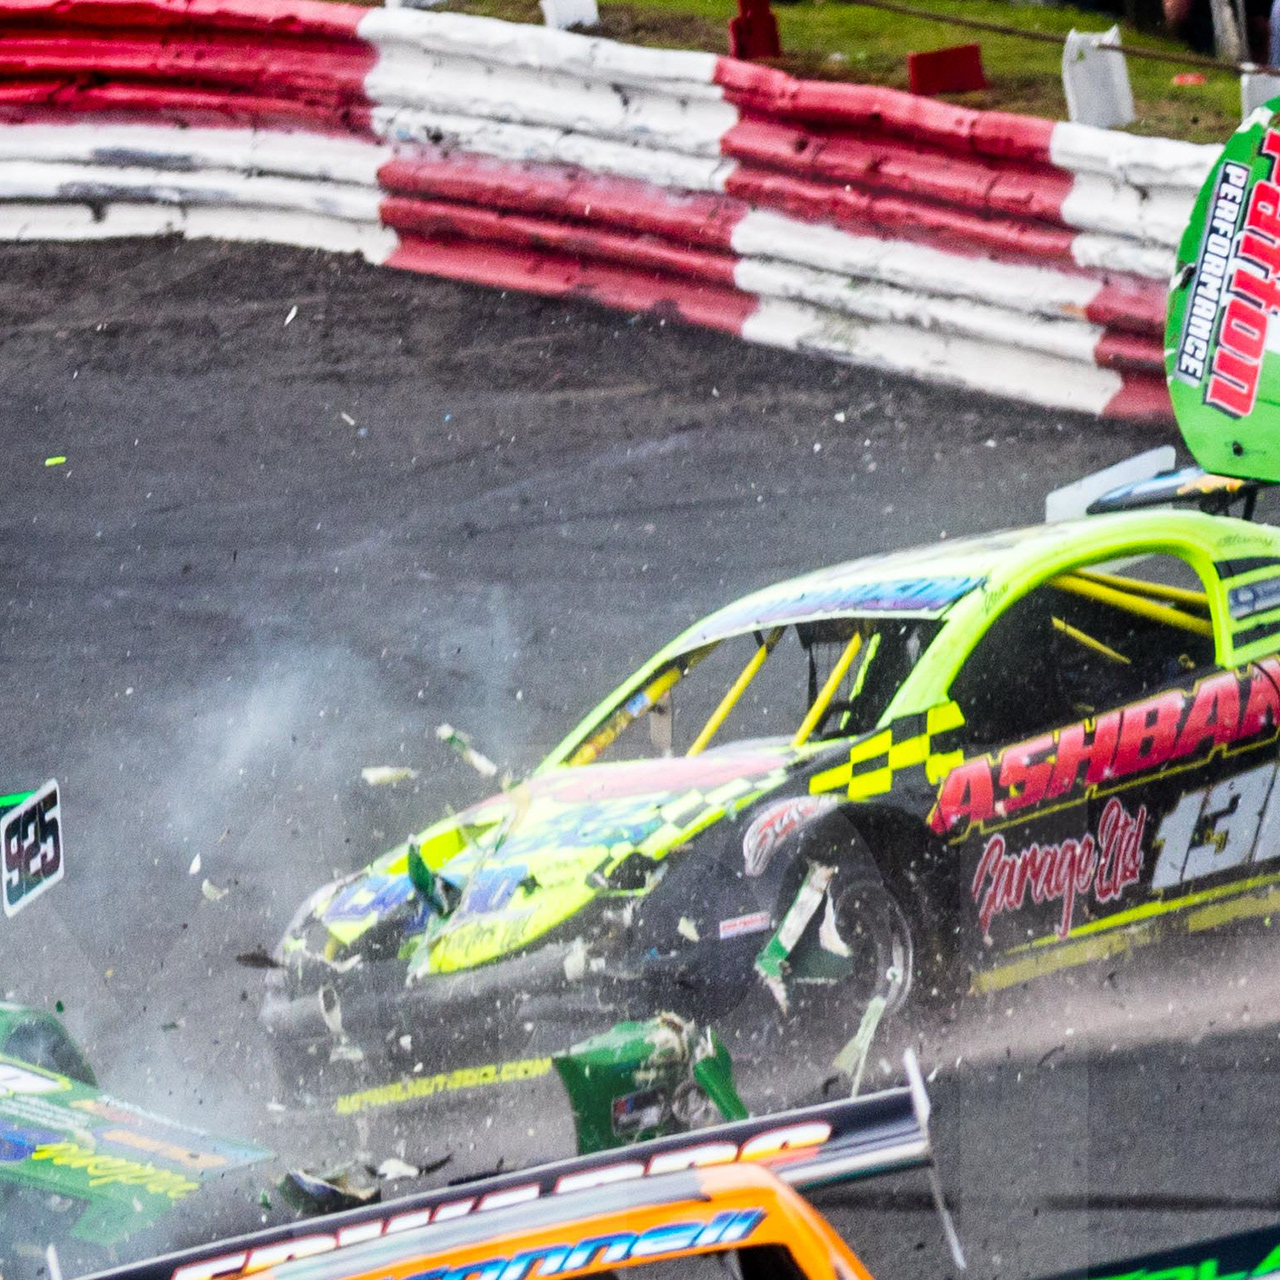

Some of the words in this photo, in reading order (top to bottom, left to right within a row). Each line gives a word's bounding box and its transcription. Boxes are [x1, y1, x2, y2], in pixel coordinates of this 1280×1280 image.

[1179, 163, 1249, 385] PERFORMANCE
[971, 833, 1096, 940] Garage
[1095, 797, 1148, 903] Ltd
